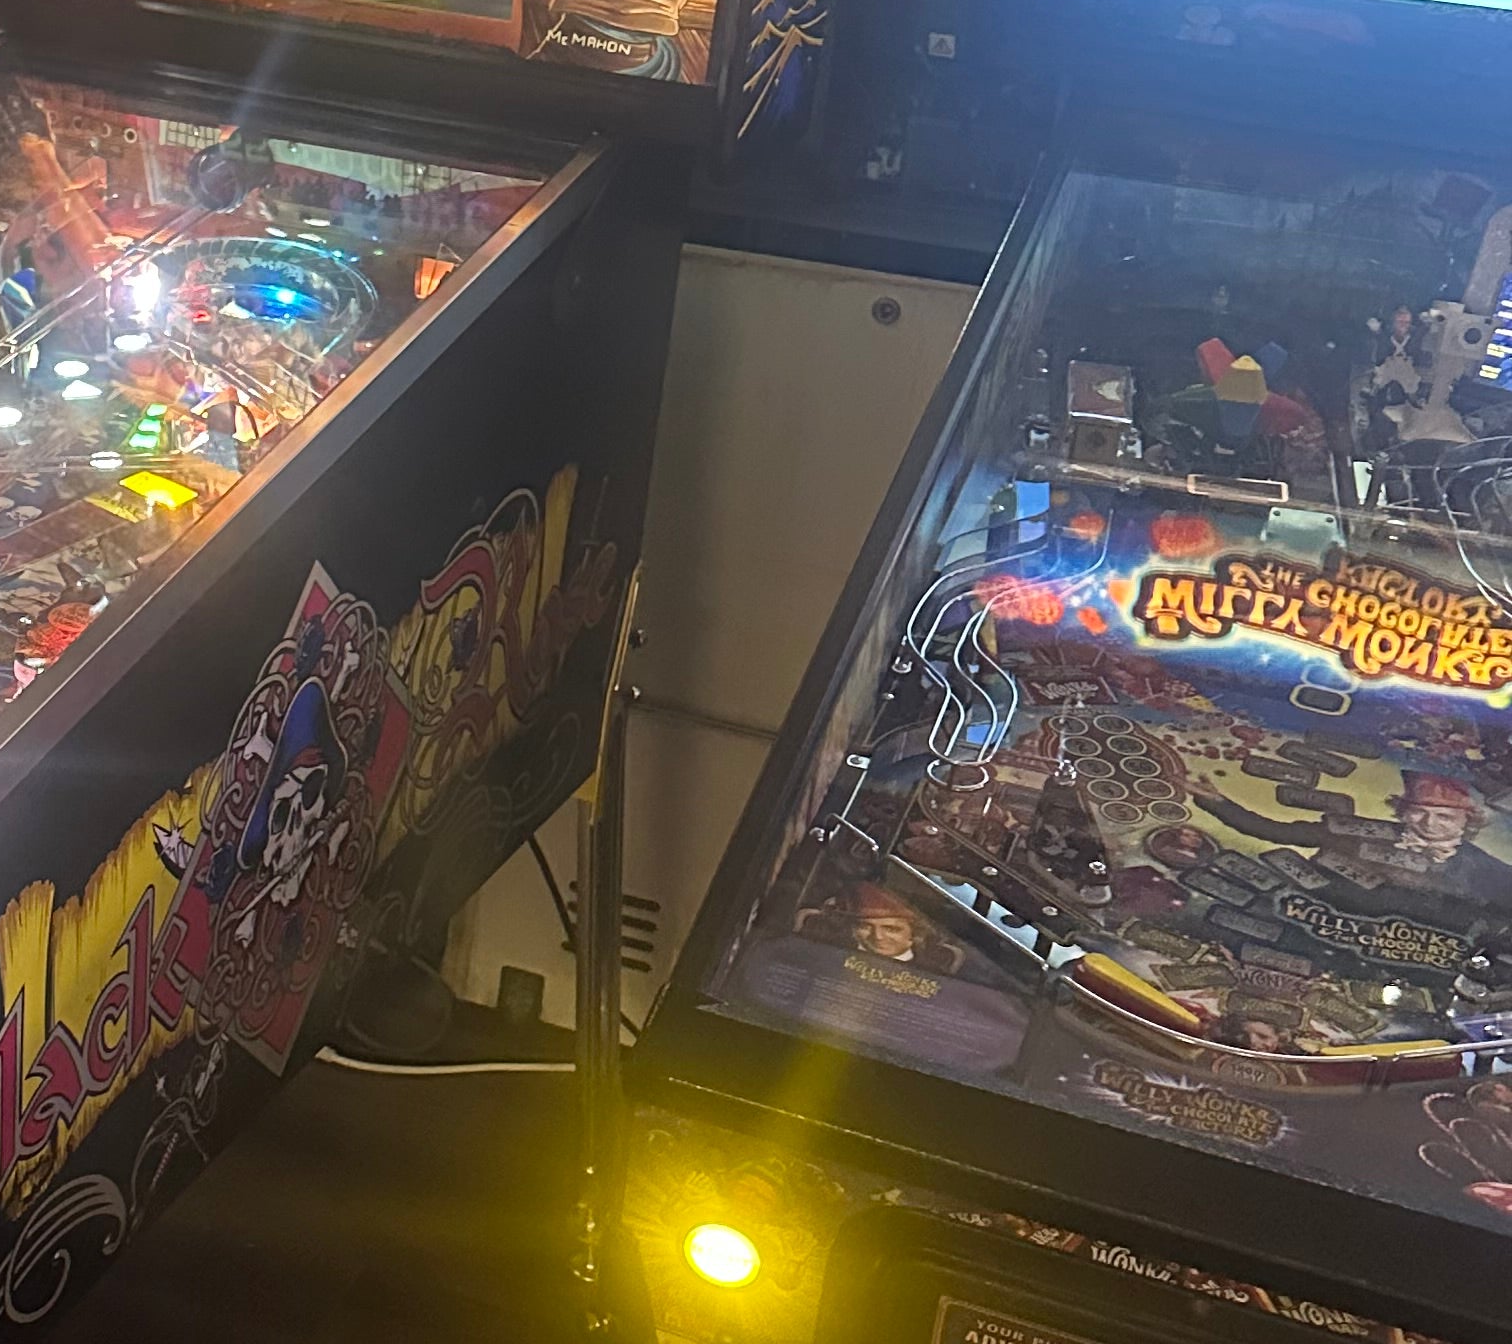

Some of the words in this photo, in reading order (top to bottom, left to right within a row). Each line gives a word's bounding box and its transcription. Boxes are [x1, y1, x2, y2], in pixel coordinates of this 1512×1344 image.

[571, 33, 632, 56] MAHON
[1286, 897, 1365, 935] WILLY
[1373, 921, 1469, 953] WONKA
[1357, 933, 1464, 962] CHOCOLATE
[1367, 945, 1453, 969] FACTORY
[977, 1319, 1025, 1342] YOUR
